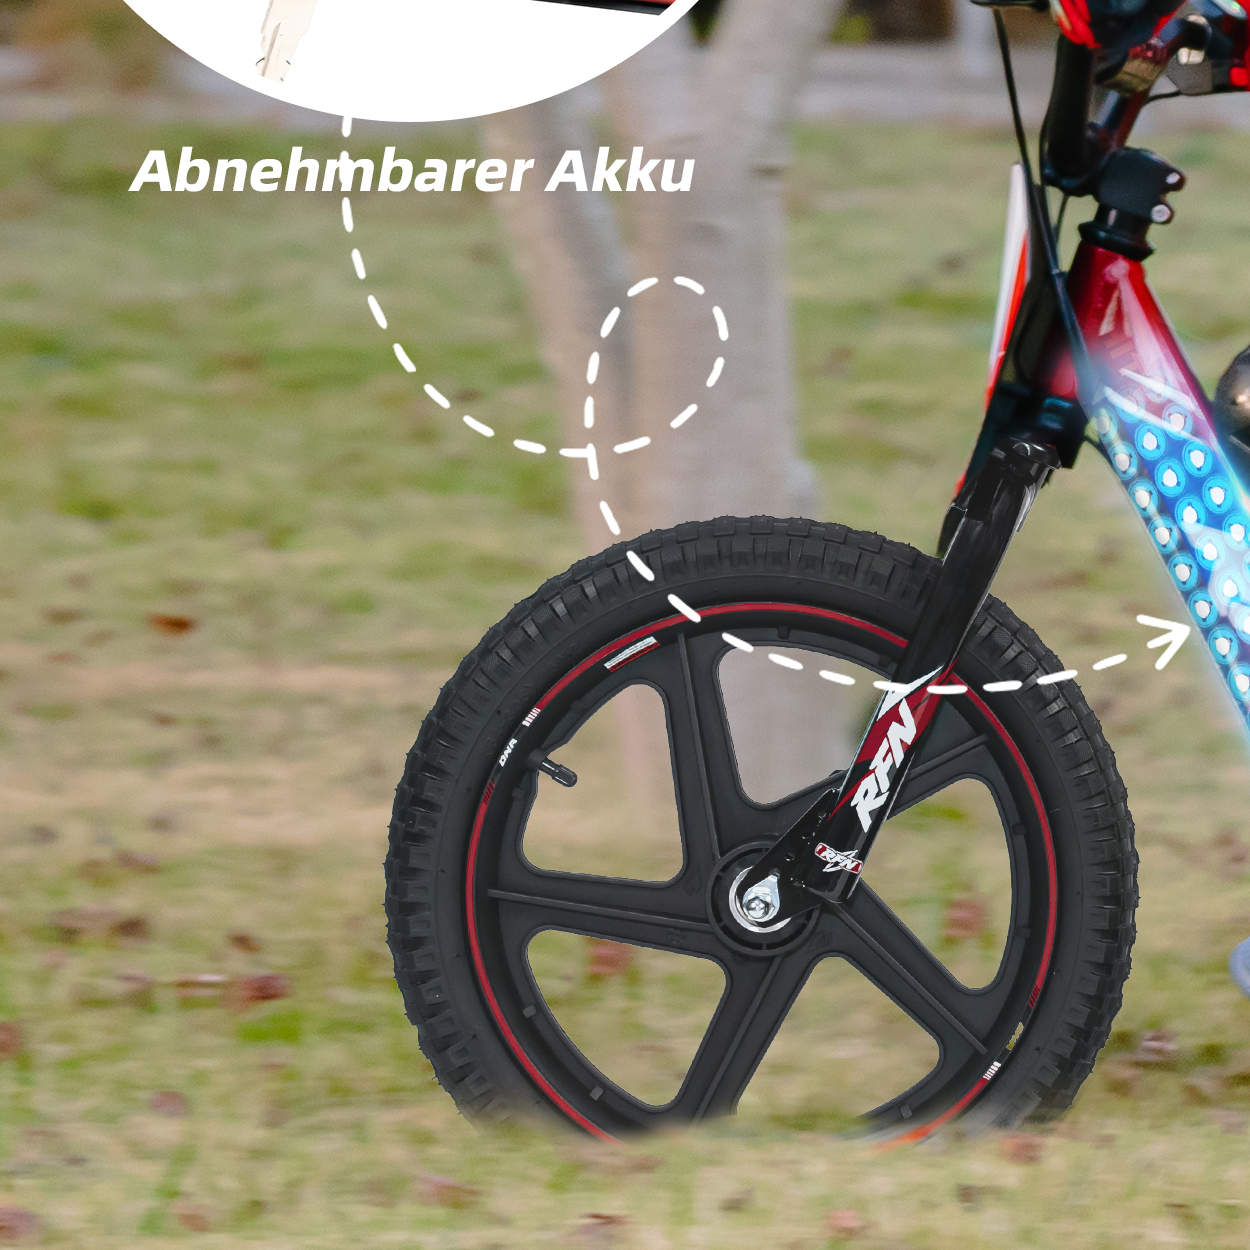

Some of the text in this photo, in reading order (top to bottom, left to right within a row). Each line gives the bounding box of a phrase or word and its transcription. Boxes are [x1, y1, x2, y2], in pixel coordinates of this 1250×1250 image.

[499, 739, 517, 767] DNA
[850, 698, 917, 833] RFN
[823, 848, 859, 870] RFN
